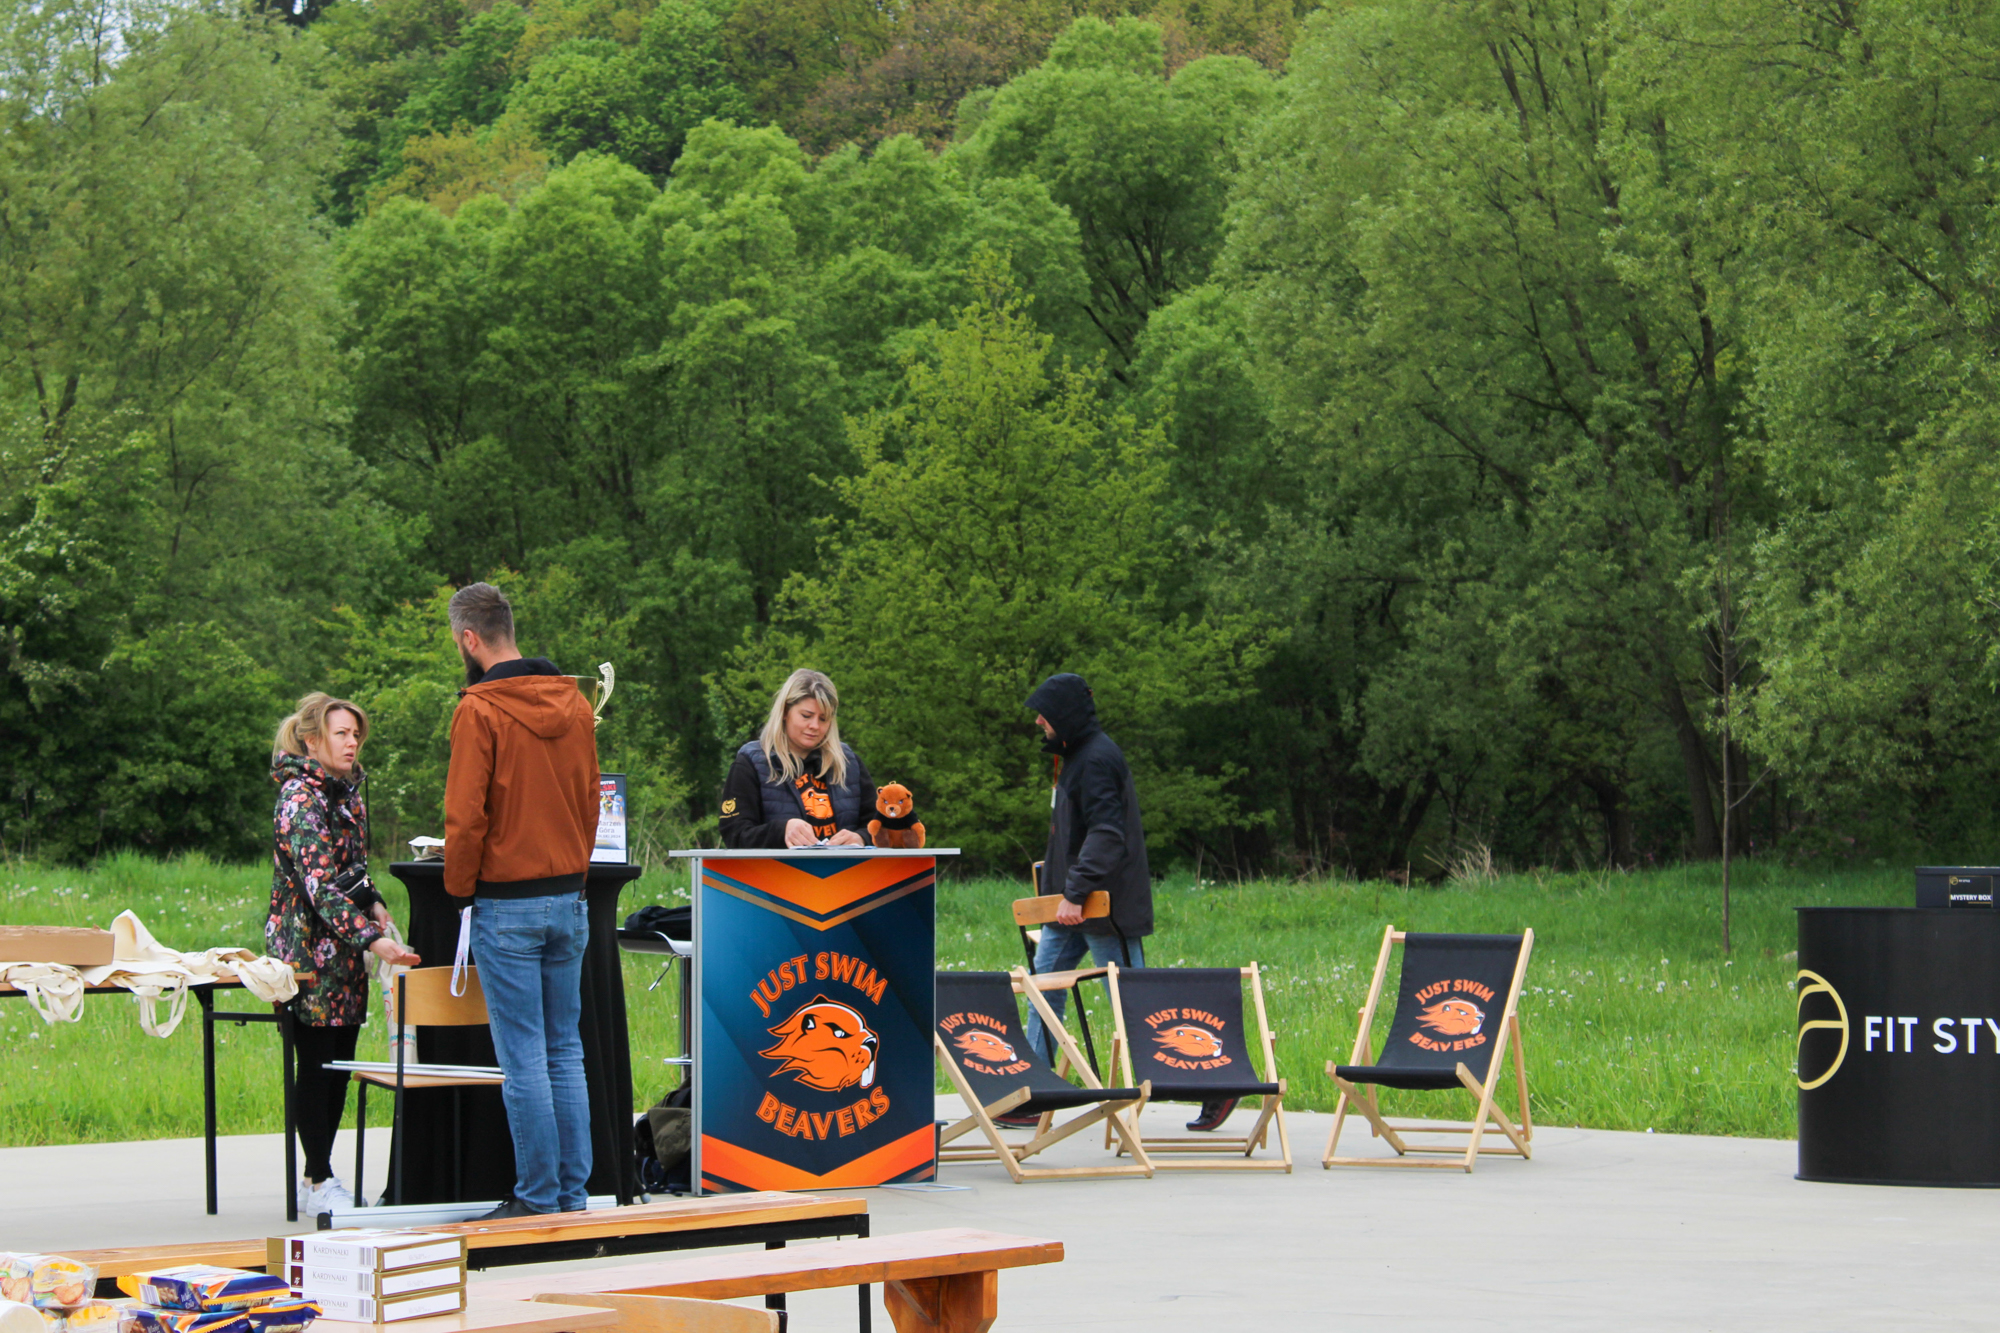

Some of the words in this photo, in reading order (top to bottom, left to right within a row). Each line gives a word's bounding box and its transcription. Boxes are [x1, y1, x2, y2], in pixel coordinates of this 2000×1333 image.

[749, 953, 808, 1018] JUST
[815, 951, 888, 1005] SWIM
[1414, 979, 1451, 1005] JUST
[1453, 979, 1495, 1003] SWIM
[939, 1012, 966, 1035] JUST
[967, 1012, 1008, 1035] SWIM
[1144, 1008, 1179, 1029] JUST
[1181, 1008, 1226, 1031] SWIM
[1408, 1031, 1487, 1052] BEAVERS
[1865, 1016, 1919, 1053] FIT
[963, 1057, 1032, 1076] BEAVERS
[1153, 1051, 1232, 1070] BEAVERS
[756, 1086, 890, 1140] BEAVERS
[313, 1297, 349, 1308] ARDYNAŁKI
